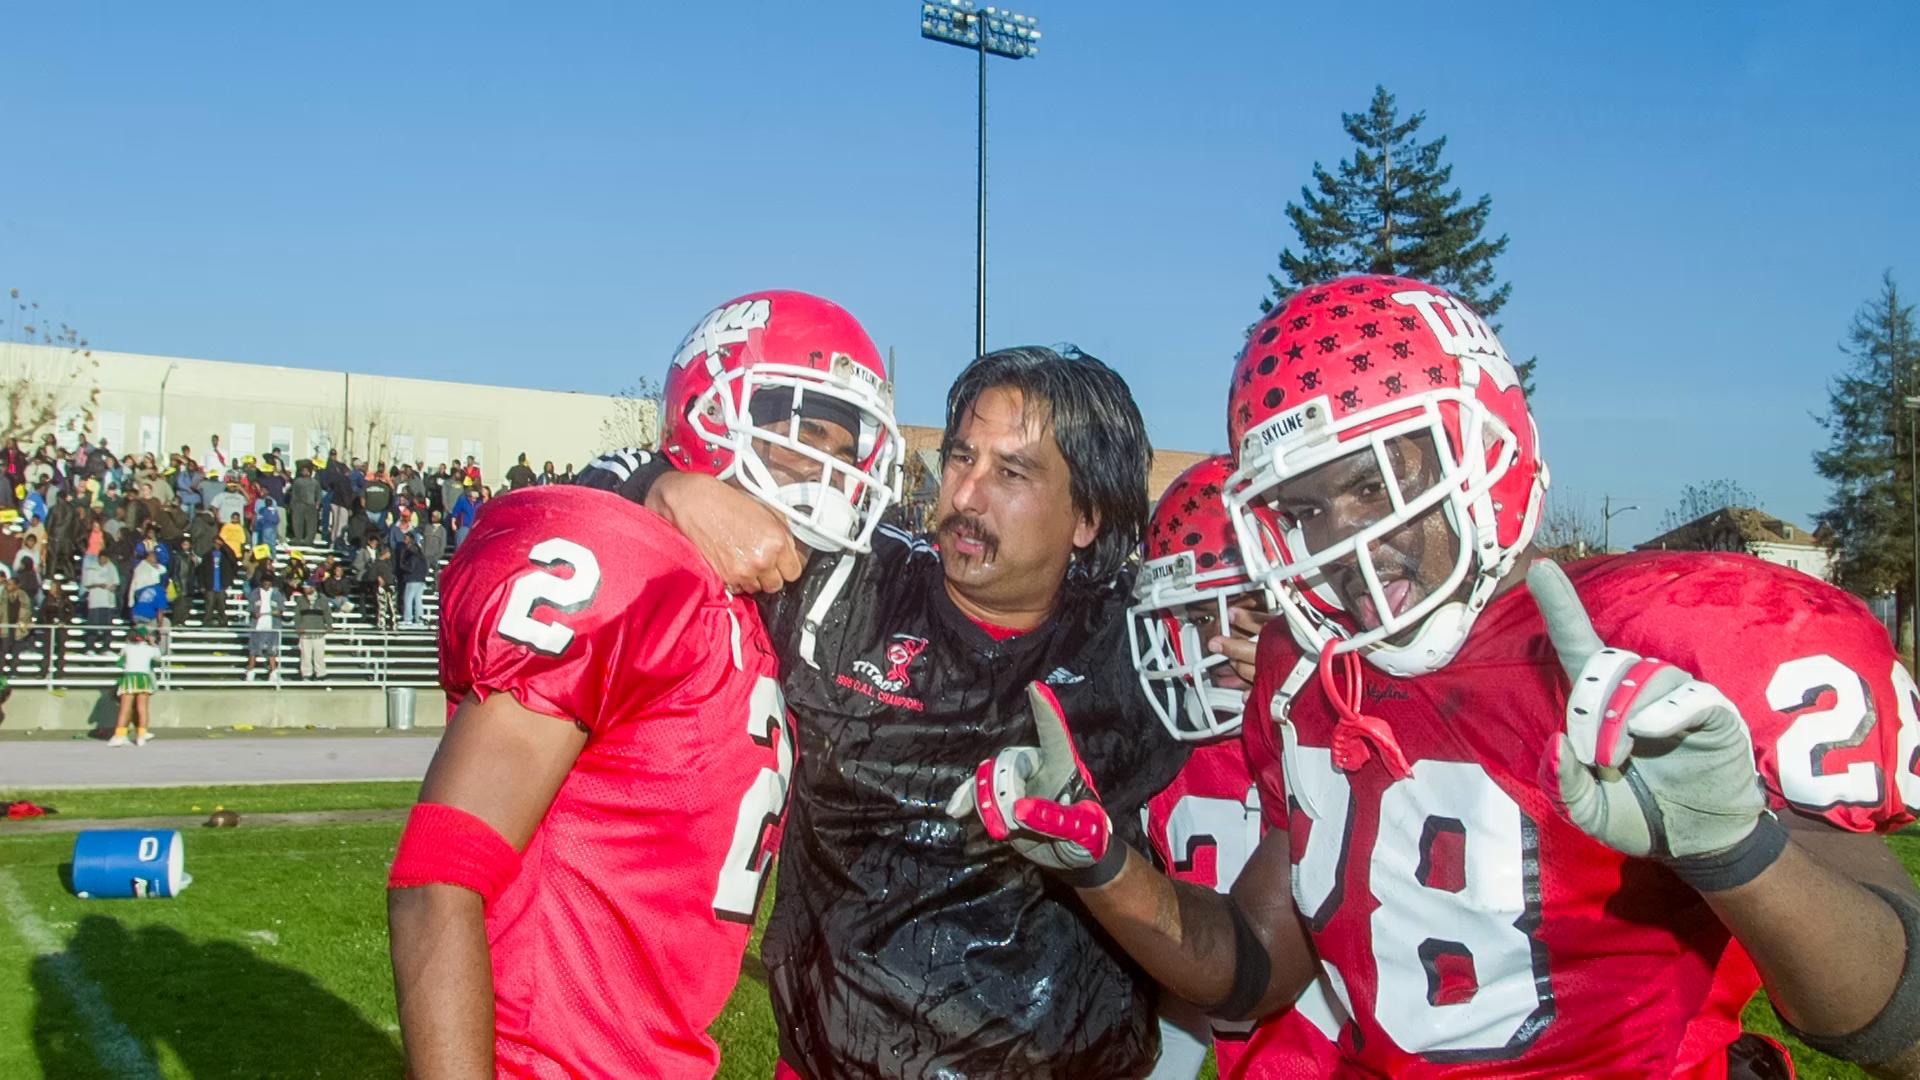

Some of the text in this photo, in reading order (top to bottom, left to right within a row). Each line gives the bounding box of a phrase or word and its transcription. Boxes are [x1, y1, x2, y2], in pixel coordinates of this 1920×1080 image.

[1261, 412, 1304, 446] SKYLINE
[497, 536, 602, 658] 2
[853, 660, 903, 691] TITANS
[877, 690, 925, 712] CHAMPIONS
[712, 672, 796, 924] 2
